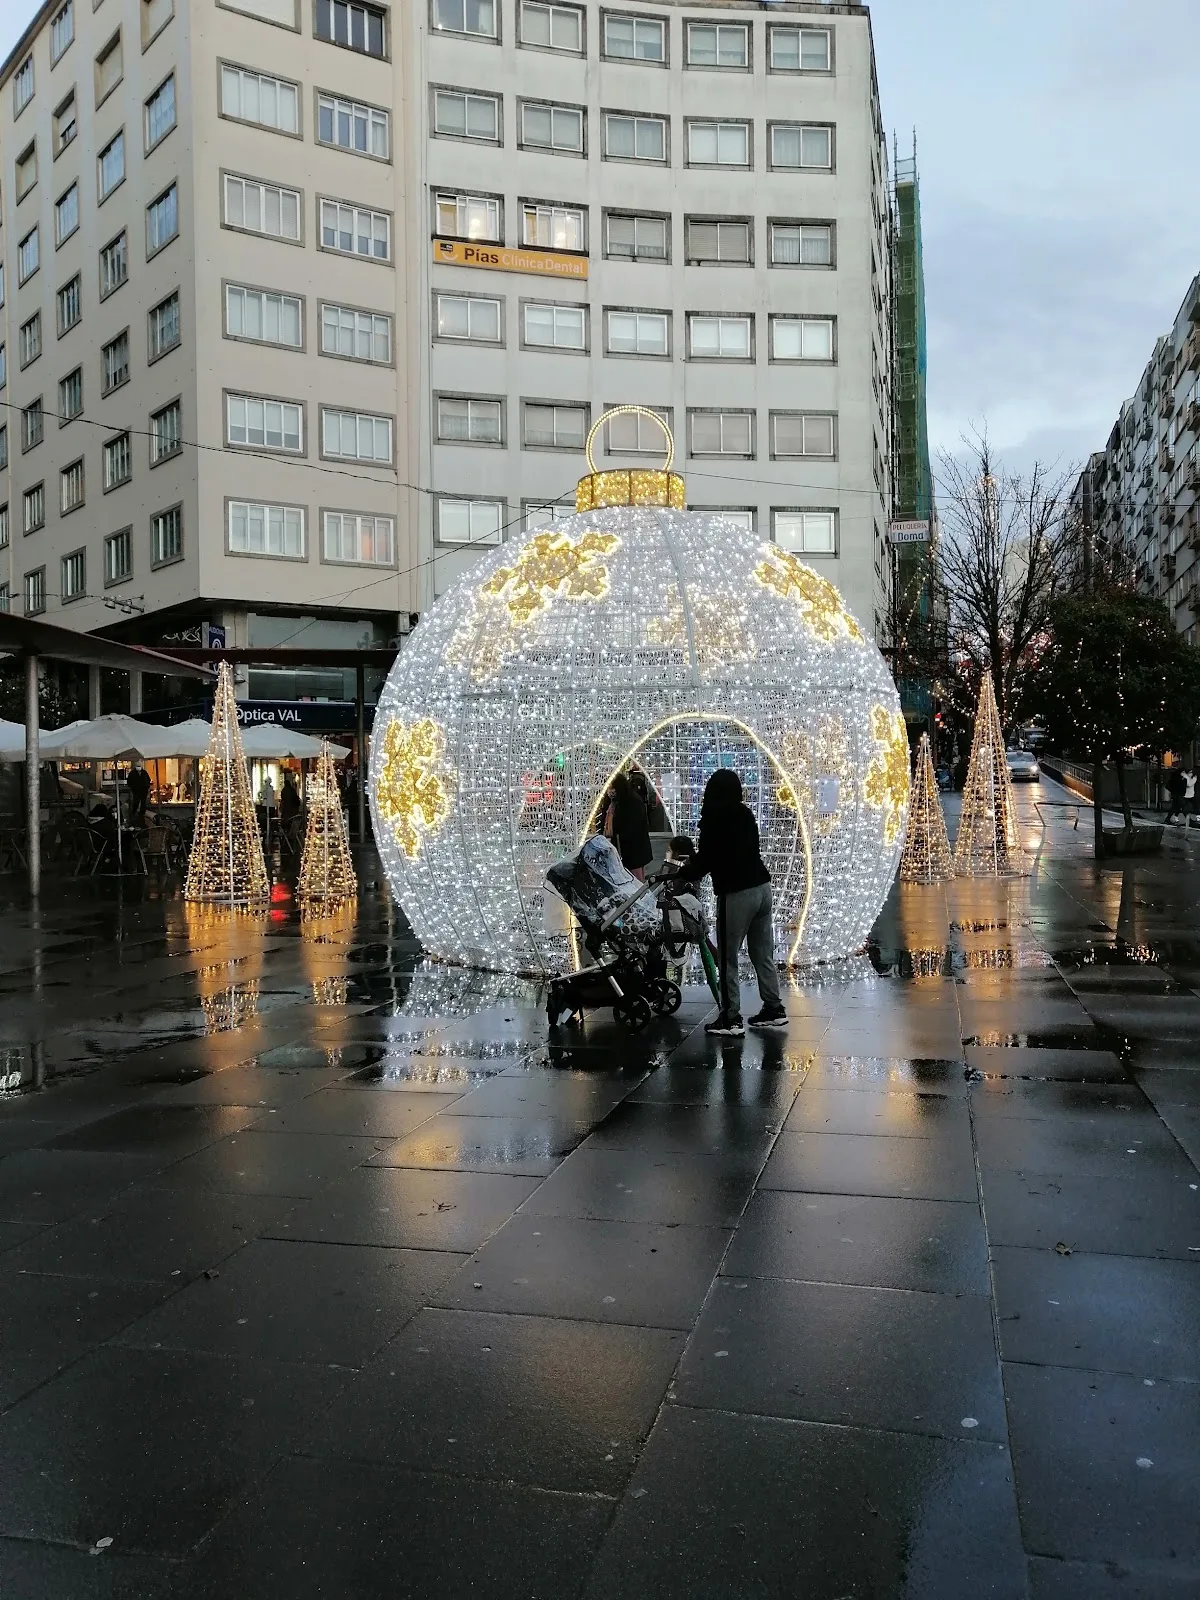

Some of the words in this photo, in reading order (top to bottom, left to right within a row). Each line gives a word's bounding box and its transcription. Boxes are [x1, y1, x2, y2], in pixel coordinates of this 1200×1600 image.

[464, 247, 499, 264] Pías
[897, 532, 924, 542] Doma
[277, 709, 302, 722] VAL
